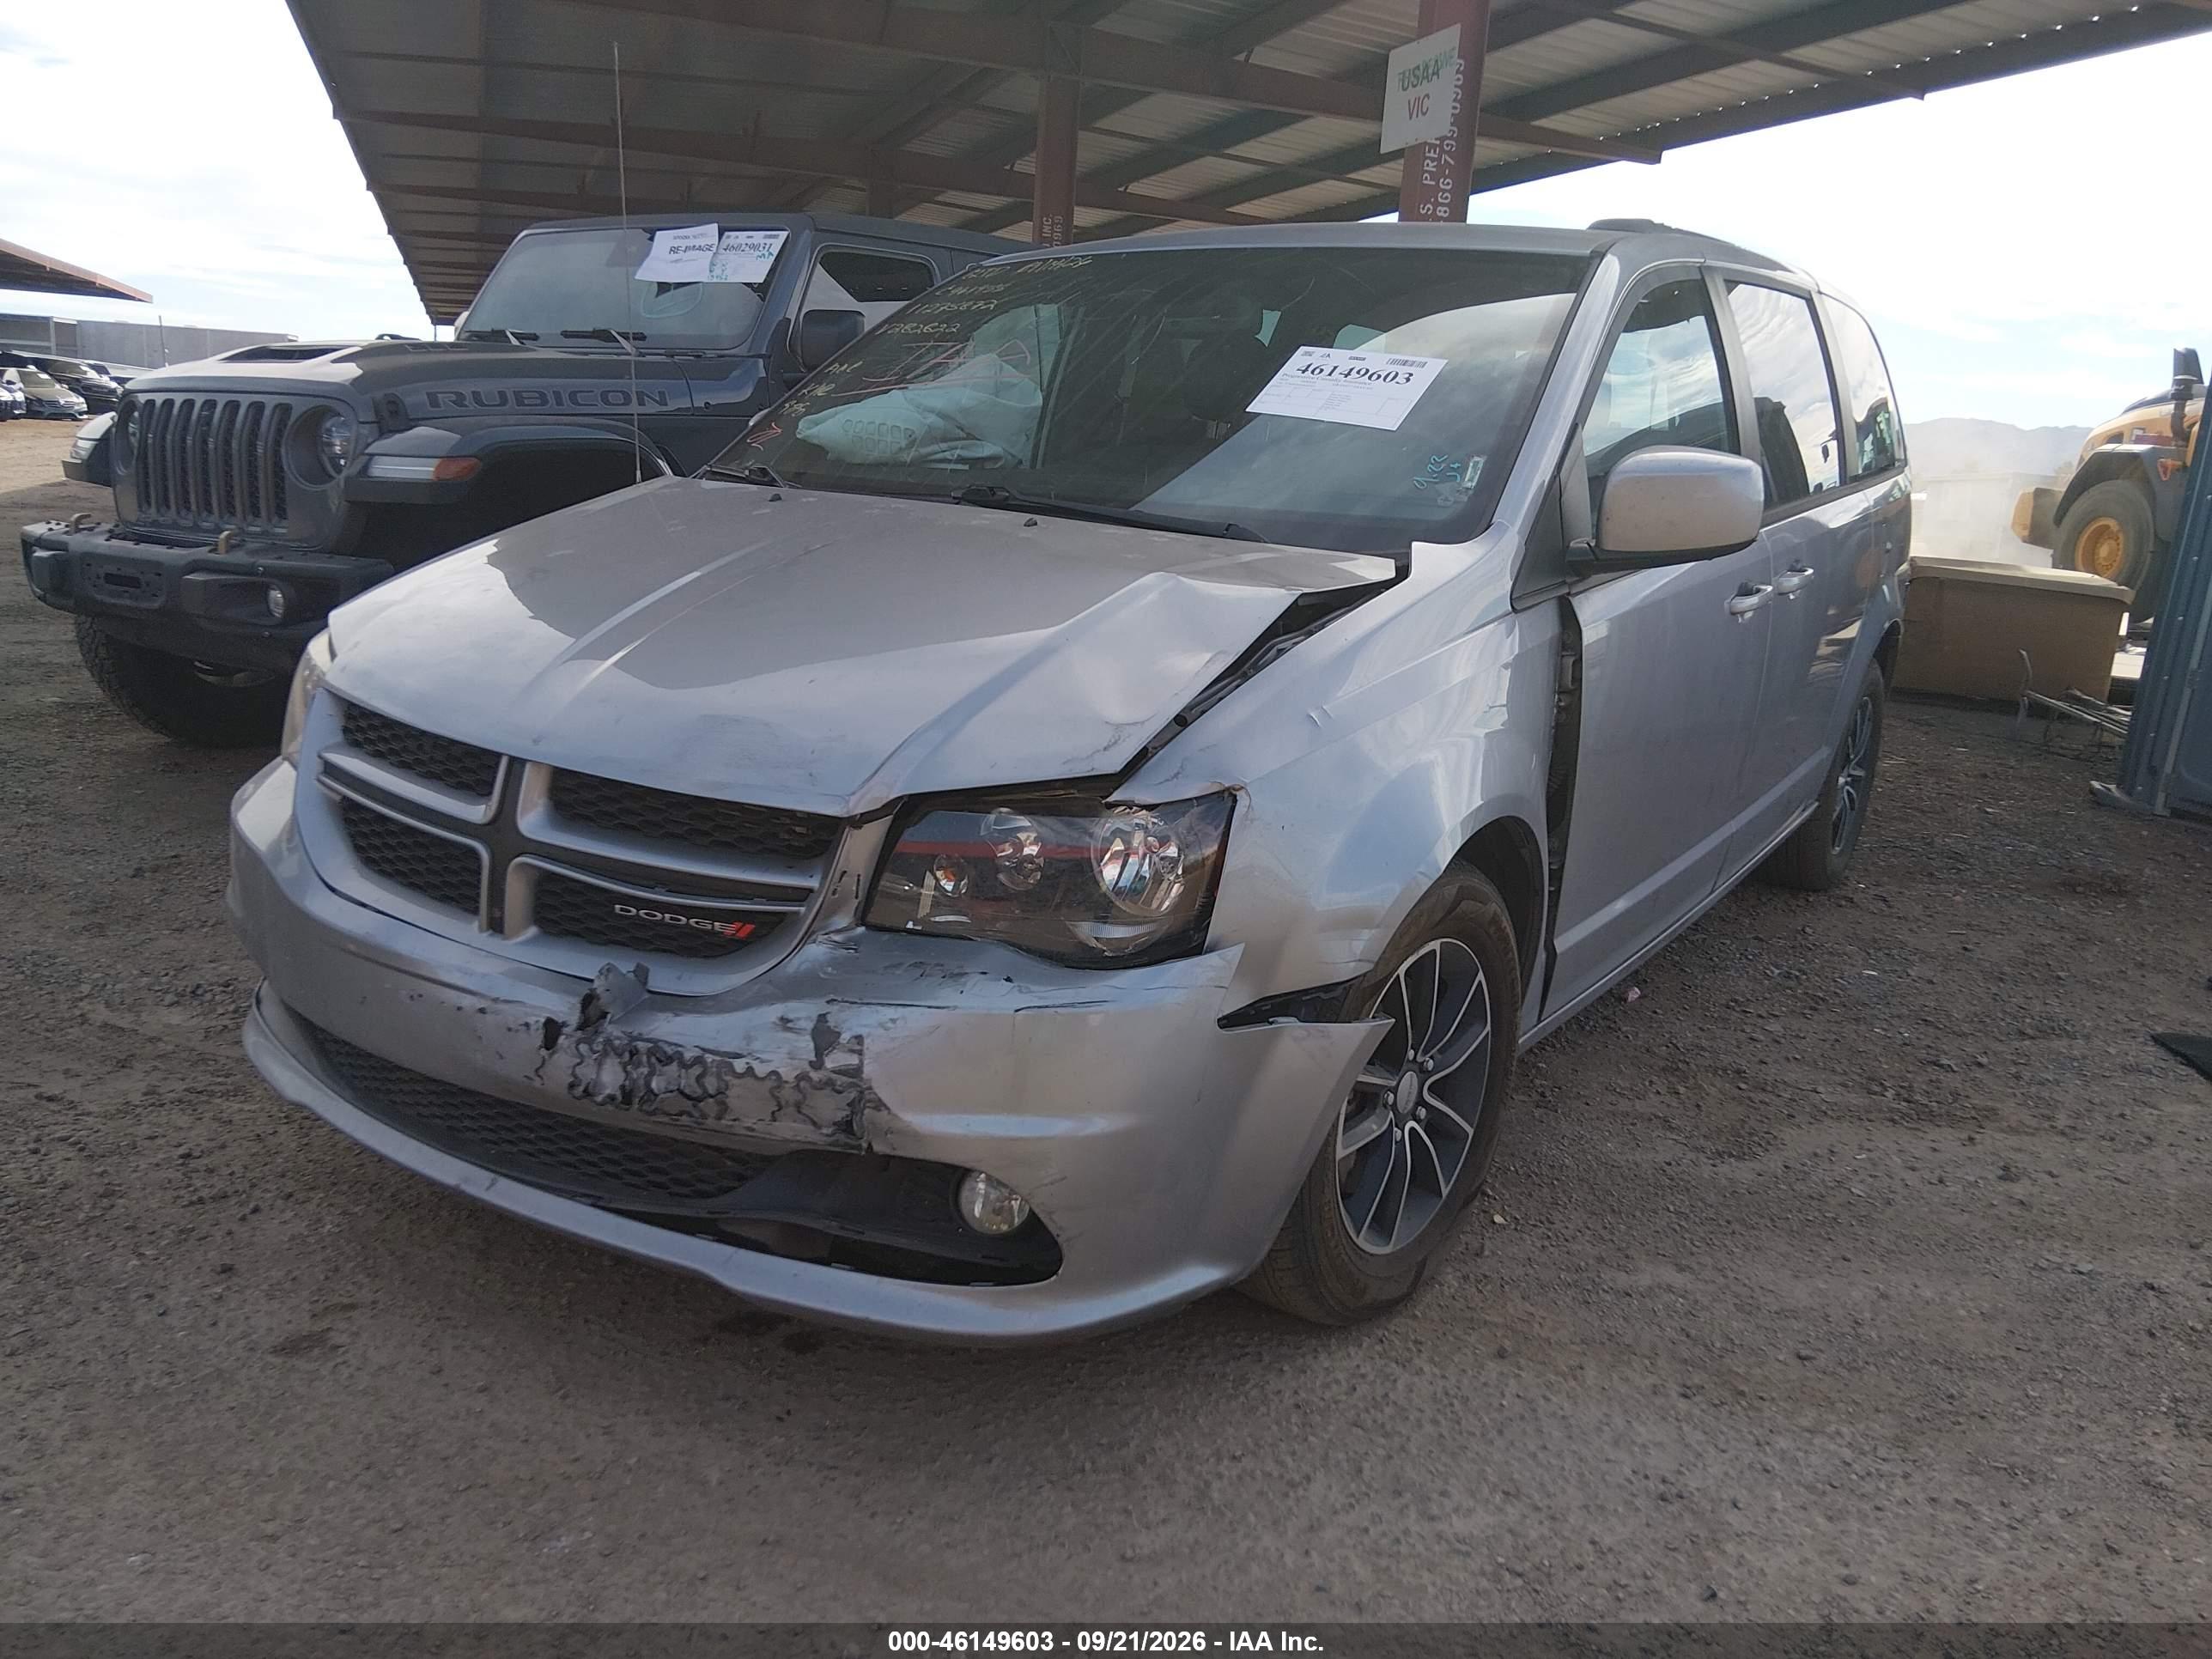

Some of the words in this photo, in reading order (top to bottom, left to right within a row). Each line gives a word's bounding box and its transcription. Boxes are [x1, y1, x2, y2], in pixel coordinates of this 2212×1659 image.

[1407, 94, 1431, 120] VIC
[722, 242, 773, 252] 46029031
[1296, 362, 1414, 386] 46149603
[425, 389, 669, 409] RUBICON
[614, 904, 737, 933] DODGE
